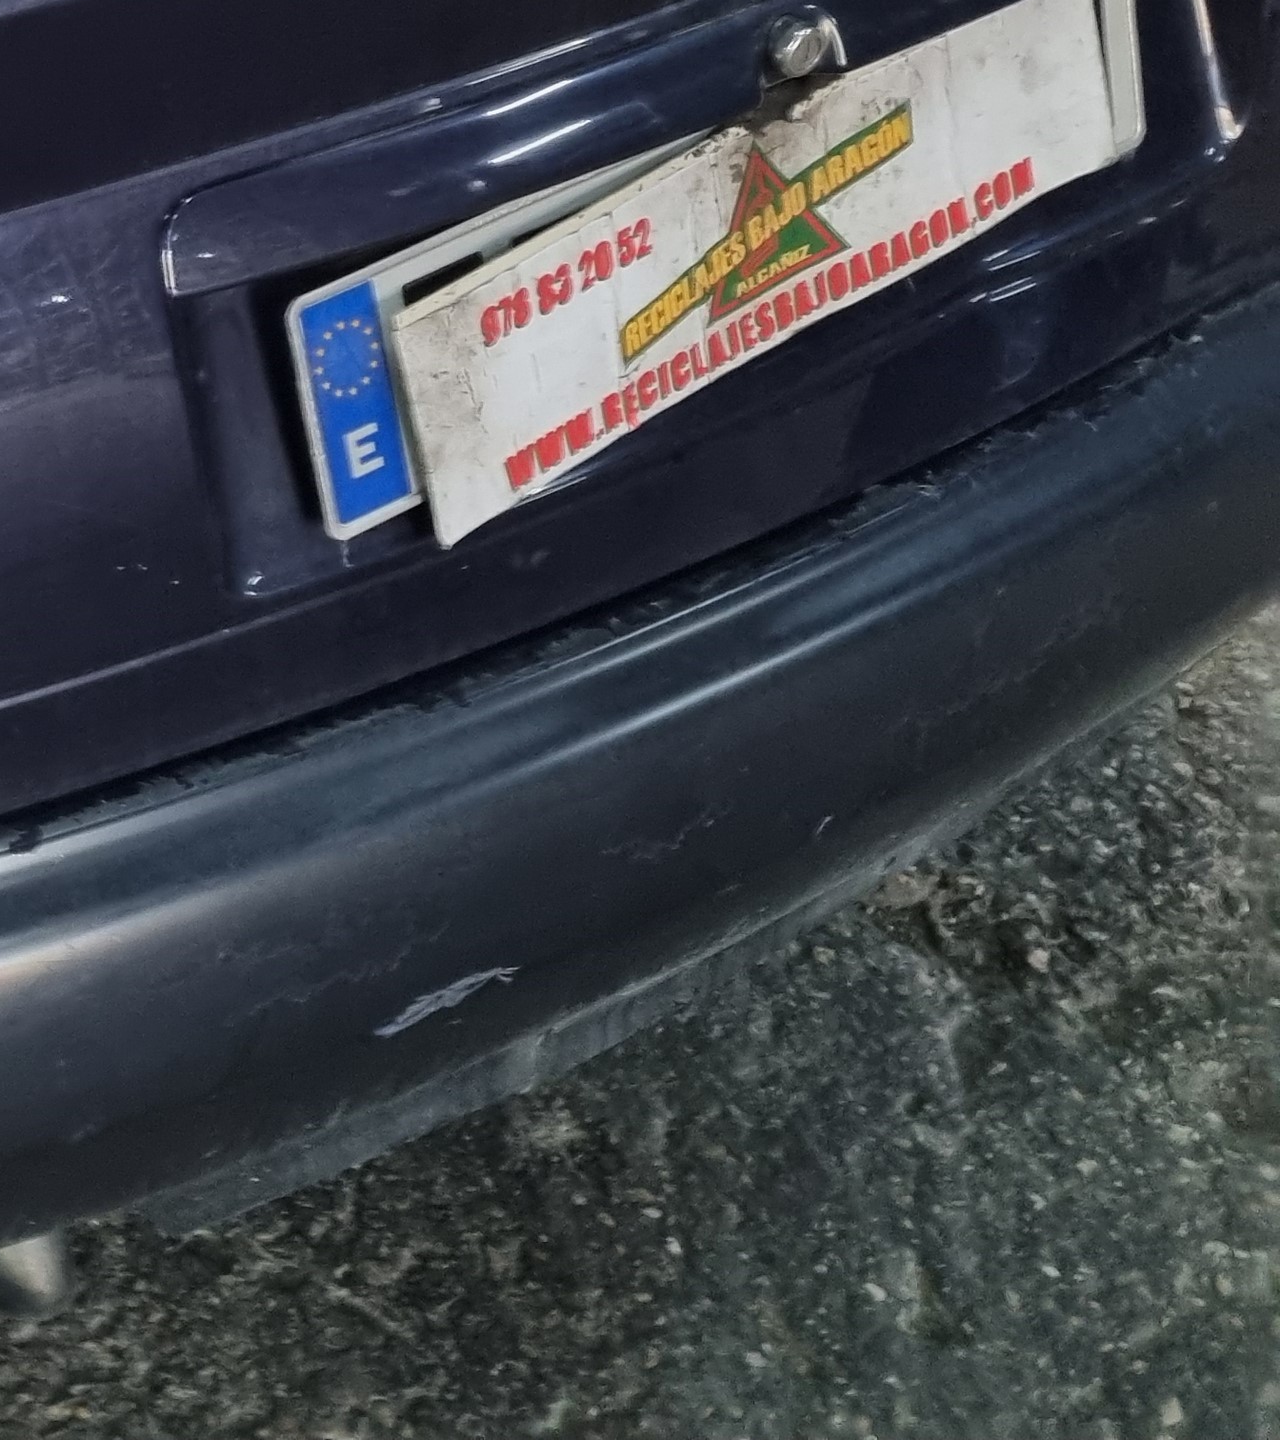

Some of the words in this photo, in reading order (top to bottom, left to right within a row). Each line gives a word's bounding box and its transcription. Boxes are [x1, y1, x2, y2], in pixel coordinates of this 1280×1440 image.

[578, 240, 613, 292] 20
[616, 218, 653, 267] 52
[623, 231, 746, 358] RECICLAJES
[745, 181, 807, 251] BAJO
[342, 422, 385, 479] E
